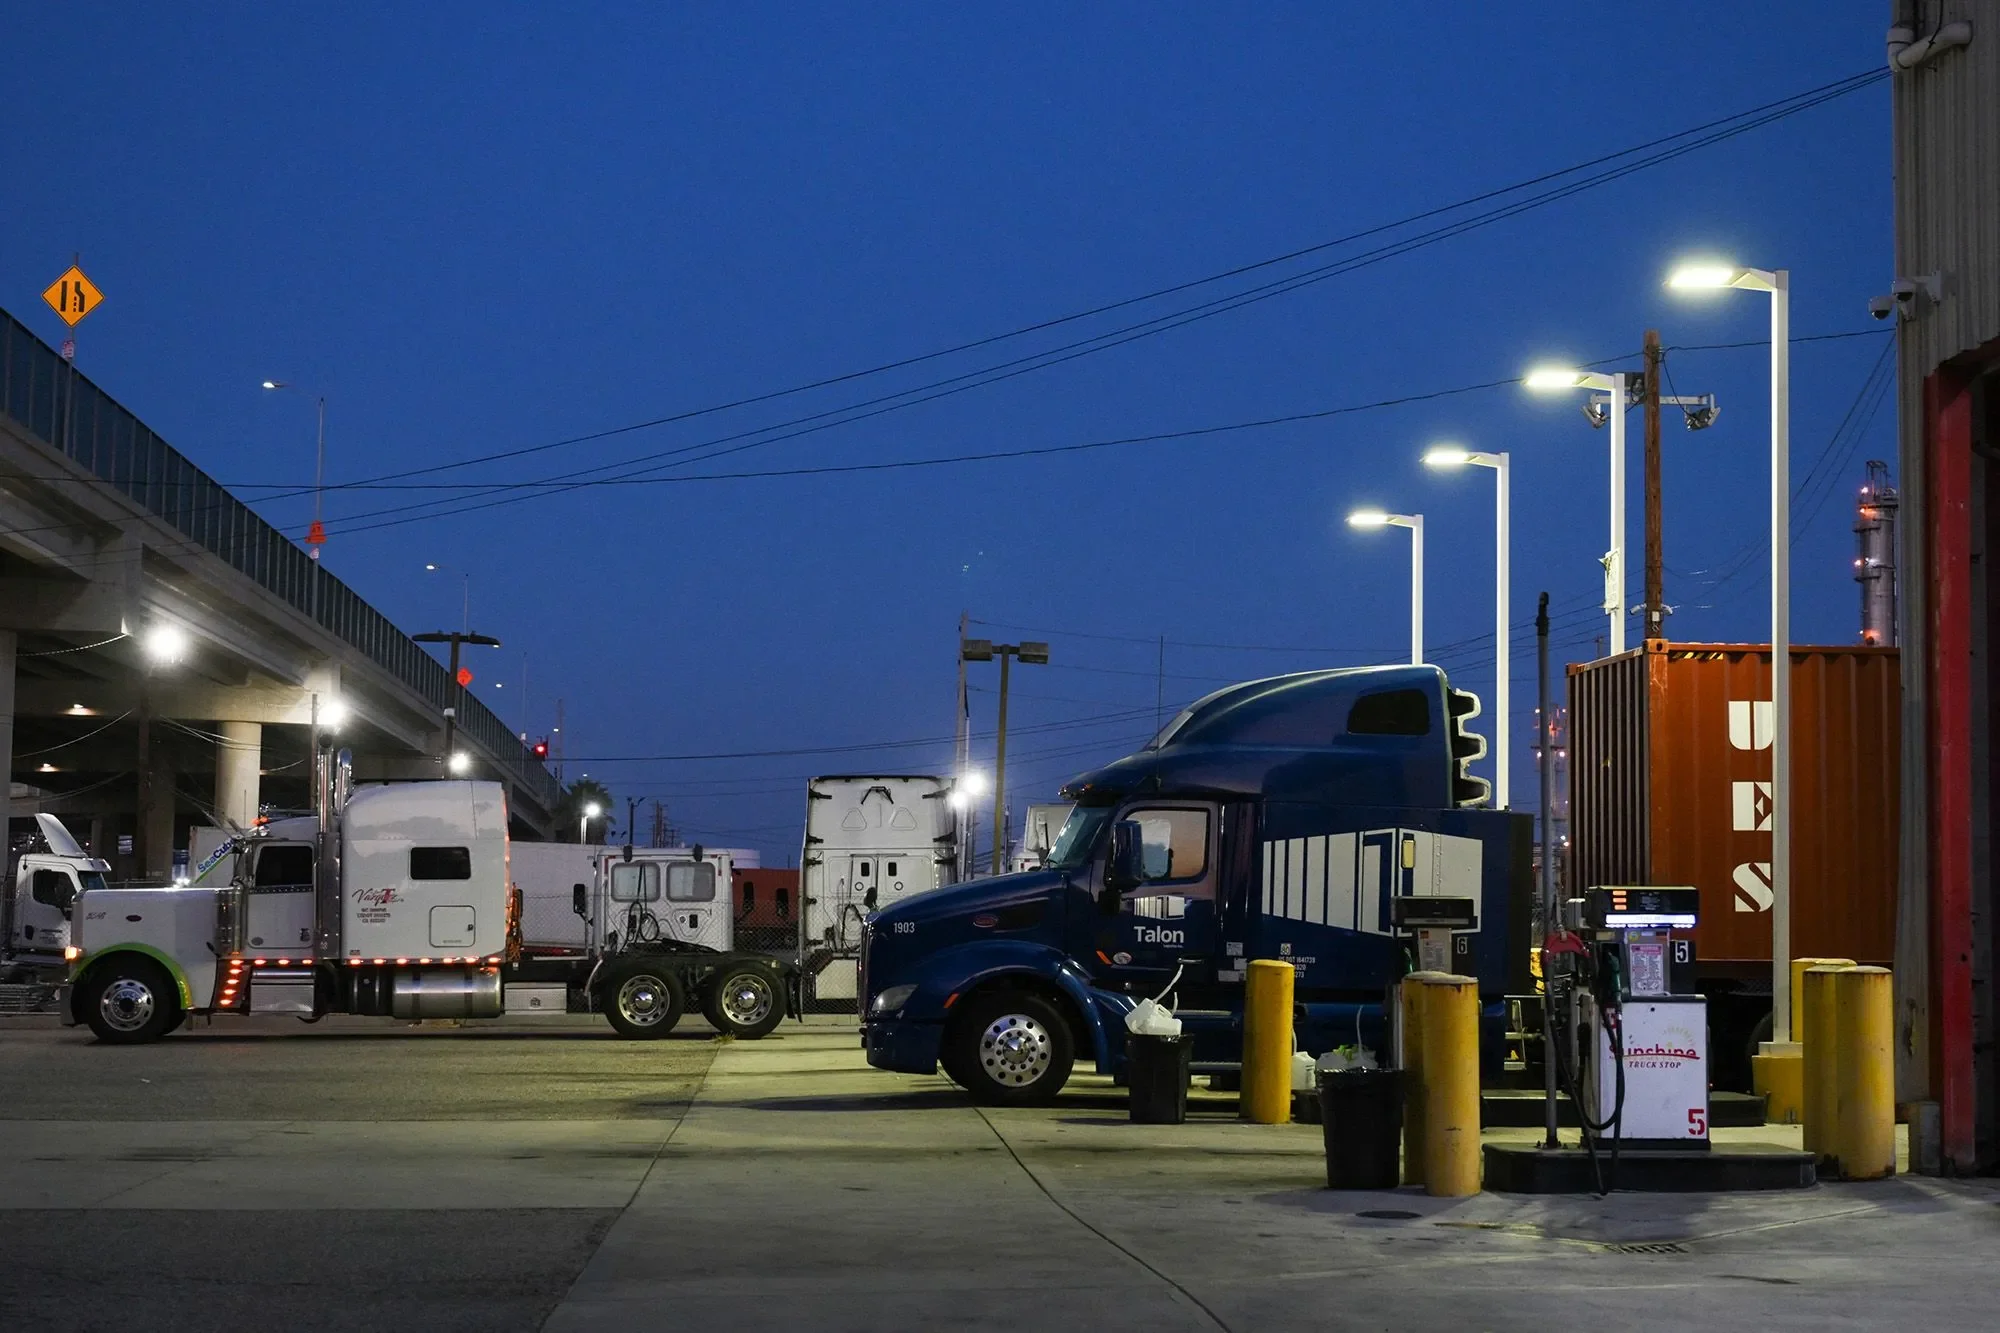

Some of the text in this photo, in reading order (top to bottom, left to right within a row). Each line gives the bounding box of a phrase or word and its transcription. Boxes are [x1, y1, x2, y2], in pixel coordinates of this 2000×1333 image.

[894, 922, 915, 933] 1903
[1133, 925, 1184, 943] Talon
[1458, 938, 1467, 953] 6
[1676, 941, 1687, 962] 5
[1628, 1061, 1682, 1069] TRUCK STOP
[1688, 1109, 1706, 1136] 5
